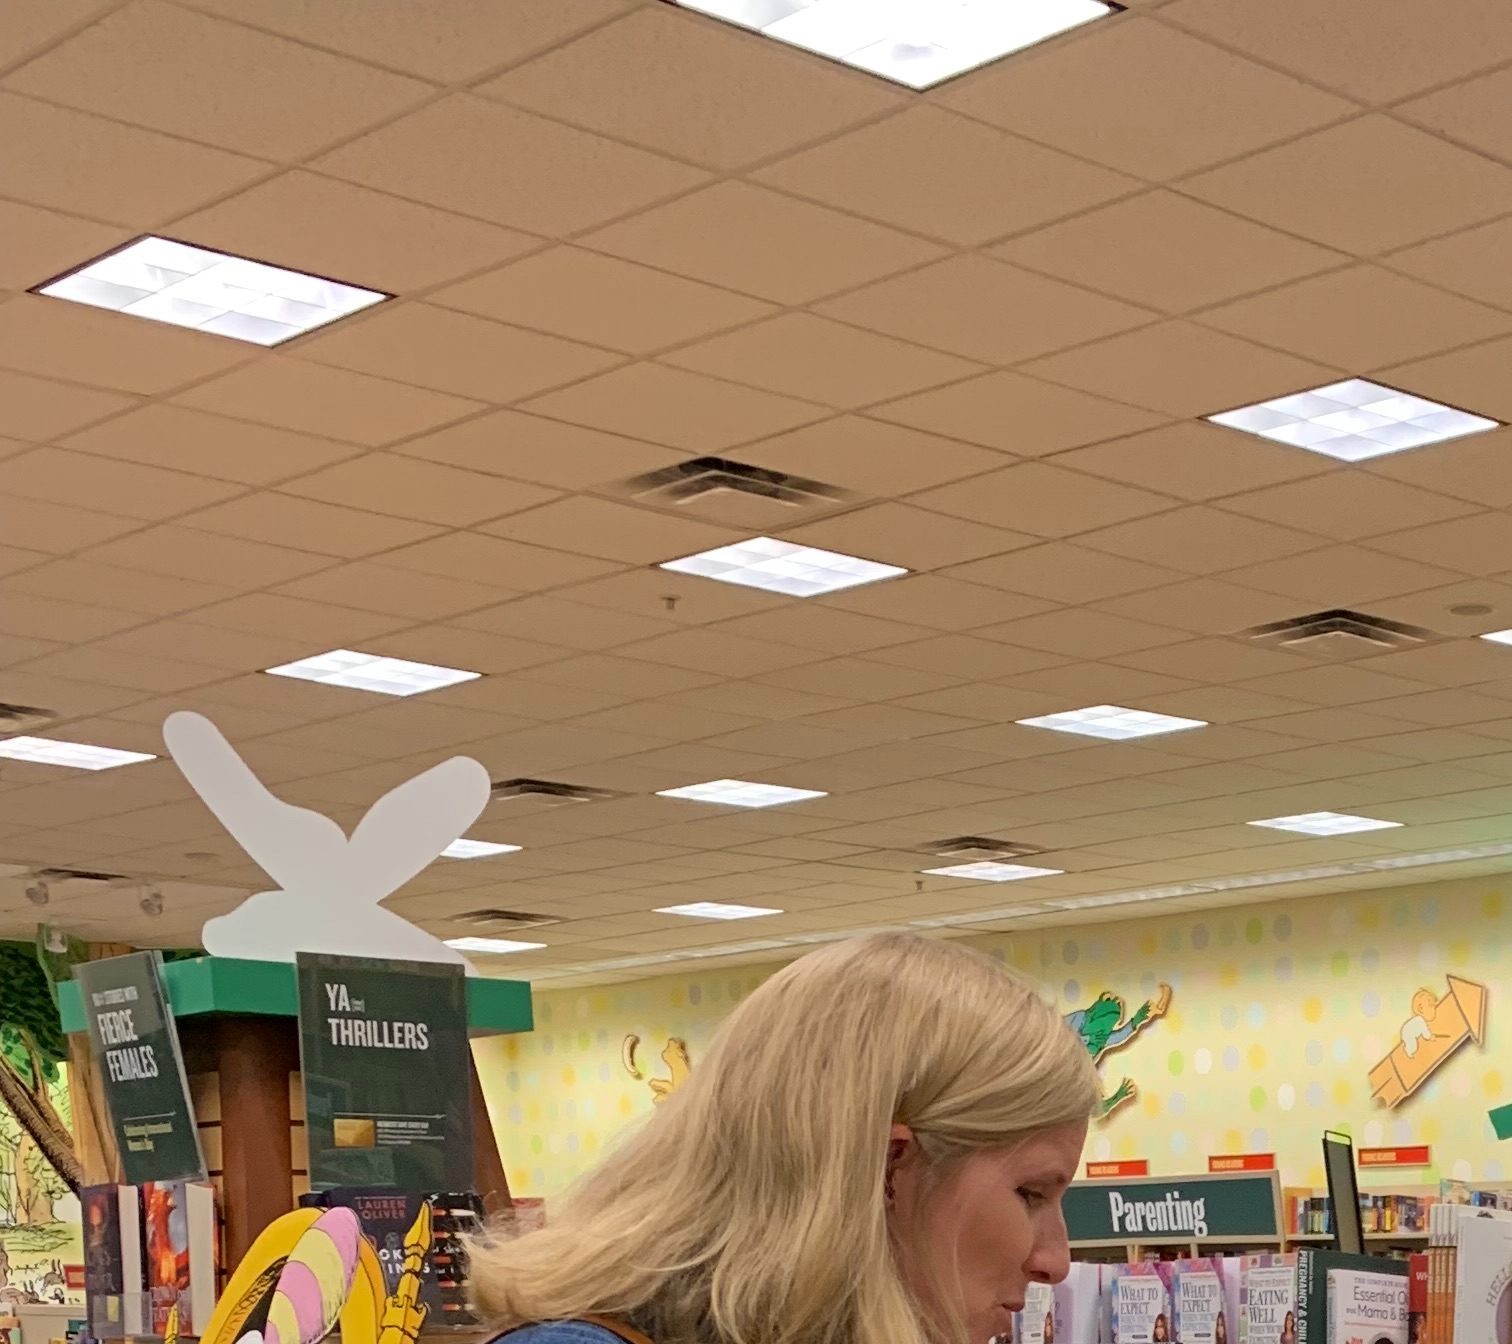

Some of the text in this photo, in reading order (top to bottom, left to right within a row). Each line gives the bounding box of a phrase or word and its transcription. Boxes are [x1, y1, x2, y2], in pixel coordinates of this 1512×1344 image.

[325, 983, 351, 1012] YA
[97, 1009, 138, 1045] FIERCE
[327, 1018, 429, 1050] THRILLERS
[106, 1046, 158, 1082] FEMALES
[357, 1199, 407, 1211] LAUREN
[1108, 1191, 1208, 1237] Parenting
[361, 1209, 407, 1220] OLIVER
[1298, 1250, 1307, 1309] PREGNANCY
[1249, 1288, 1289, 1306] EATING
[1353, 1287, 1396, 1305] Essential
[1249, 1307, 1277, 1324] WELL
[1300, 1310, 1307, 1318] &
[1357, 1306, 1387, 1320] Mama
